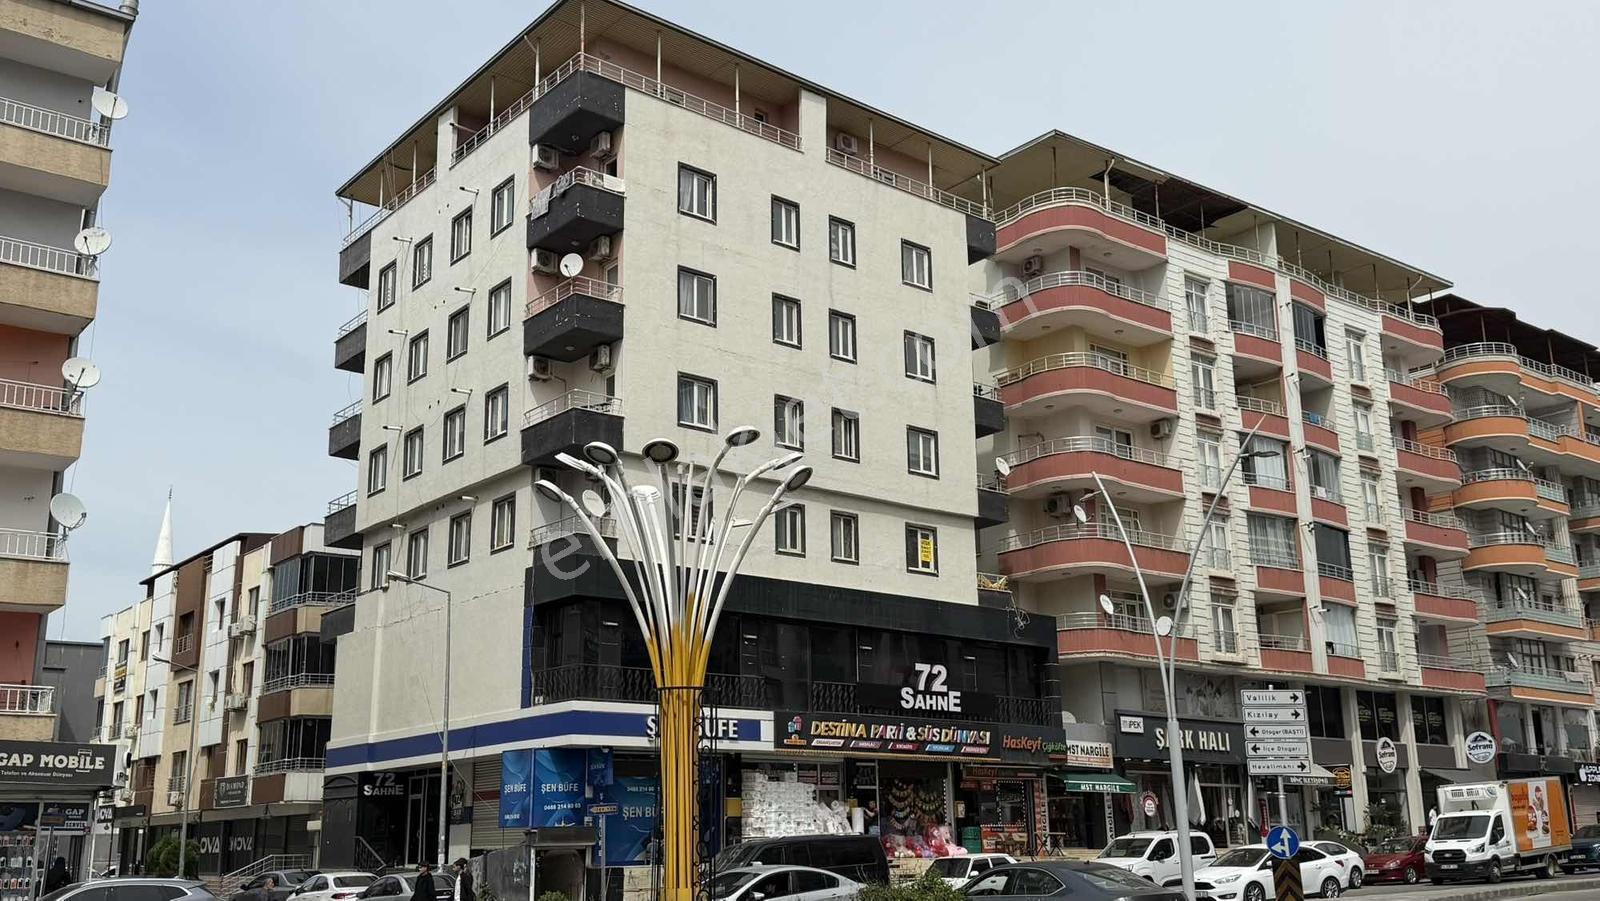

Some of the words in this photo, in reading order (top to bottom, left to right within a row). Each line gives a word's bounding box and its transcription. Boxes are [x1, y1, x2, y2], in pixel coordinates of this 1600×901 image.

[915, 663, 947, 692] 72
[901, 687, 961, 712] SAHNE
[1246, 694, 1277, 702] Valilik
[810, 718, 867, 738] DESTİNA
[869, 722, 904, 741] PARTİ
[905, 726, 917, 741] &
[917, 724, 941, 742] SÜS
[941, 726, 991, 745] DÜNYASI
[1198, 730, 1231, 752] HALI
[0, 753, 34, 767] GAP
[373, 772, 396, 787] 72
[363, 784, 405, 796] SAHNE
[541, 783, 557, 795] ŞEN
[558, 781, 579, 793] BÜFE
[65, 808, 86, 816] GAP
[622, 806, 643, 821] ŞEN
